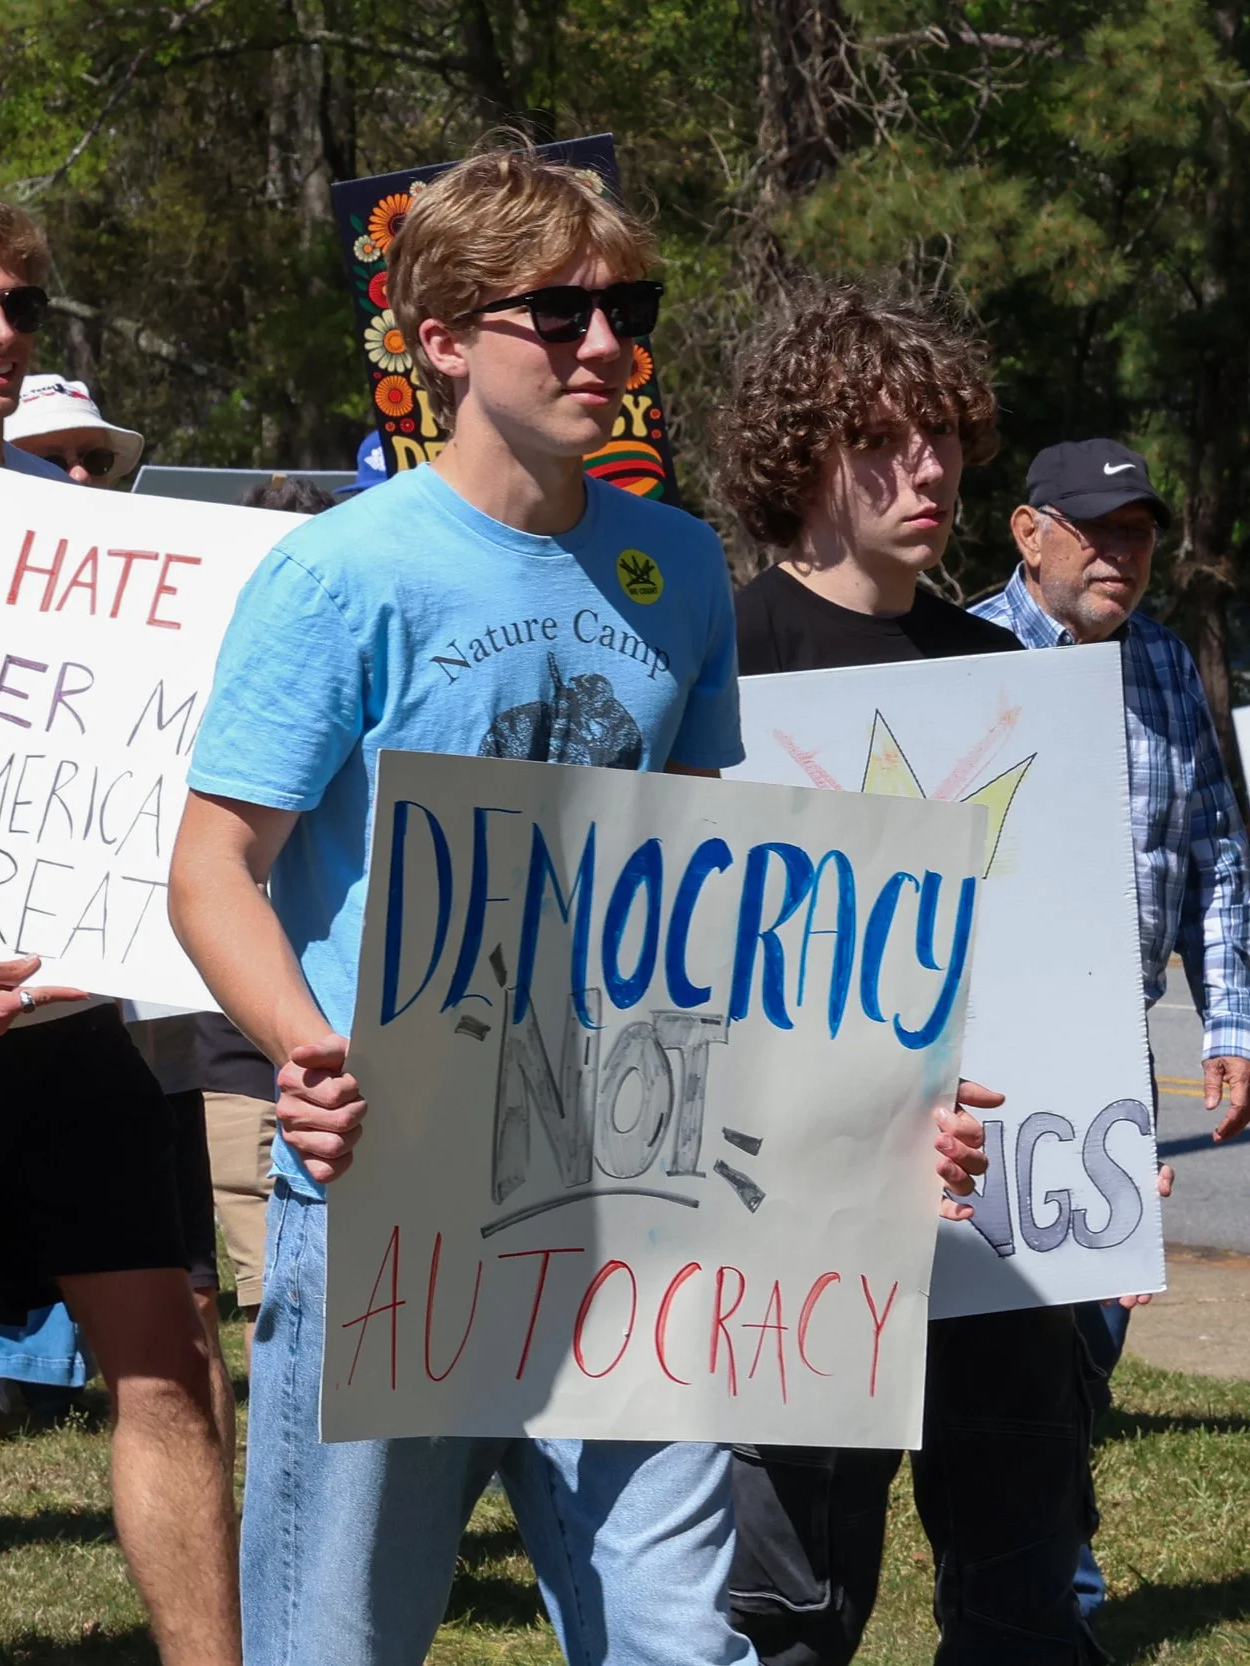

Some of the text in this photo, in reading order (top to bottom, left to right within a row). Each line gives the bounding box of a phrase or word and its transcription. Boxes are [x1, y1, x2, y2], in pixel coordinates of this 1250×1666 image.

[6, 530, 202, 630] HATE
[429, 608, 671, 686] Nature Camp
[127, 679, 207, 757] M
[381, 800, 976, 1050] DEMOCRACY
[491, 986, 730, 1206] NOT
[944, 1098, 1152, 1258] NGS
[342, 1225, 898, 1405] AUTOCRACY
